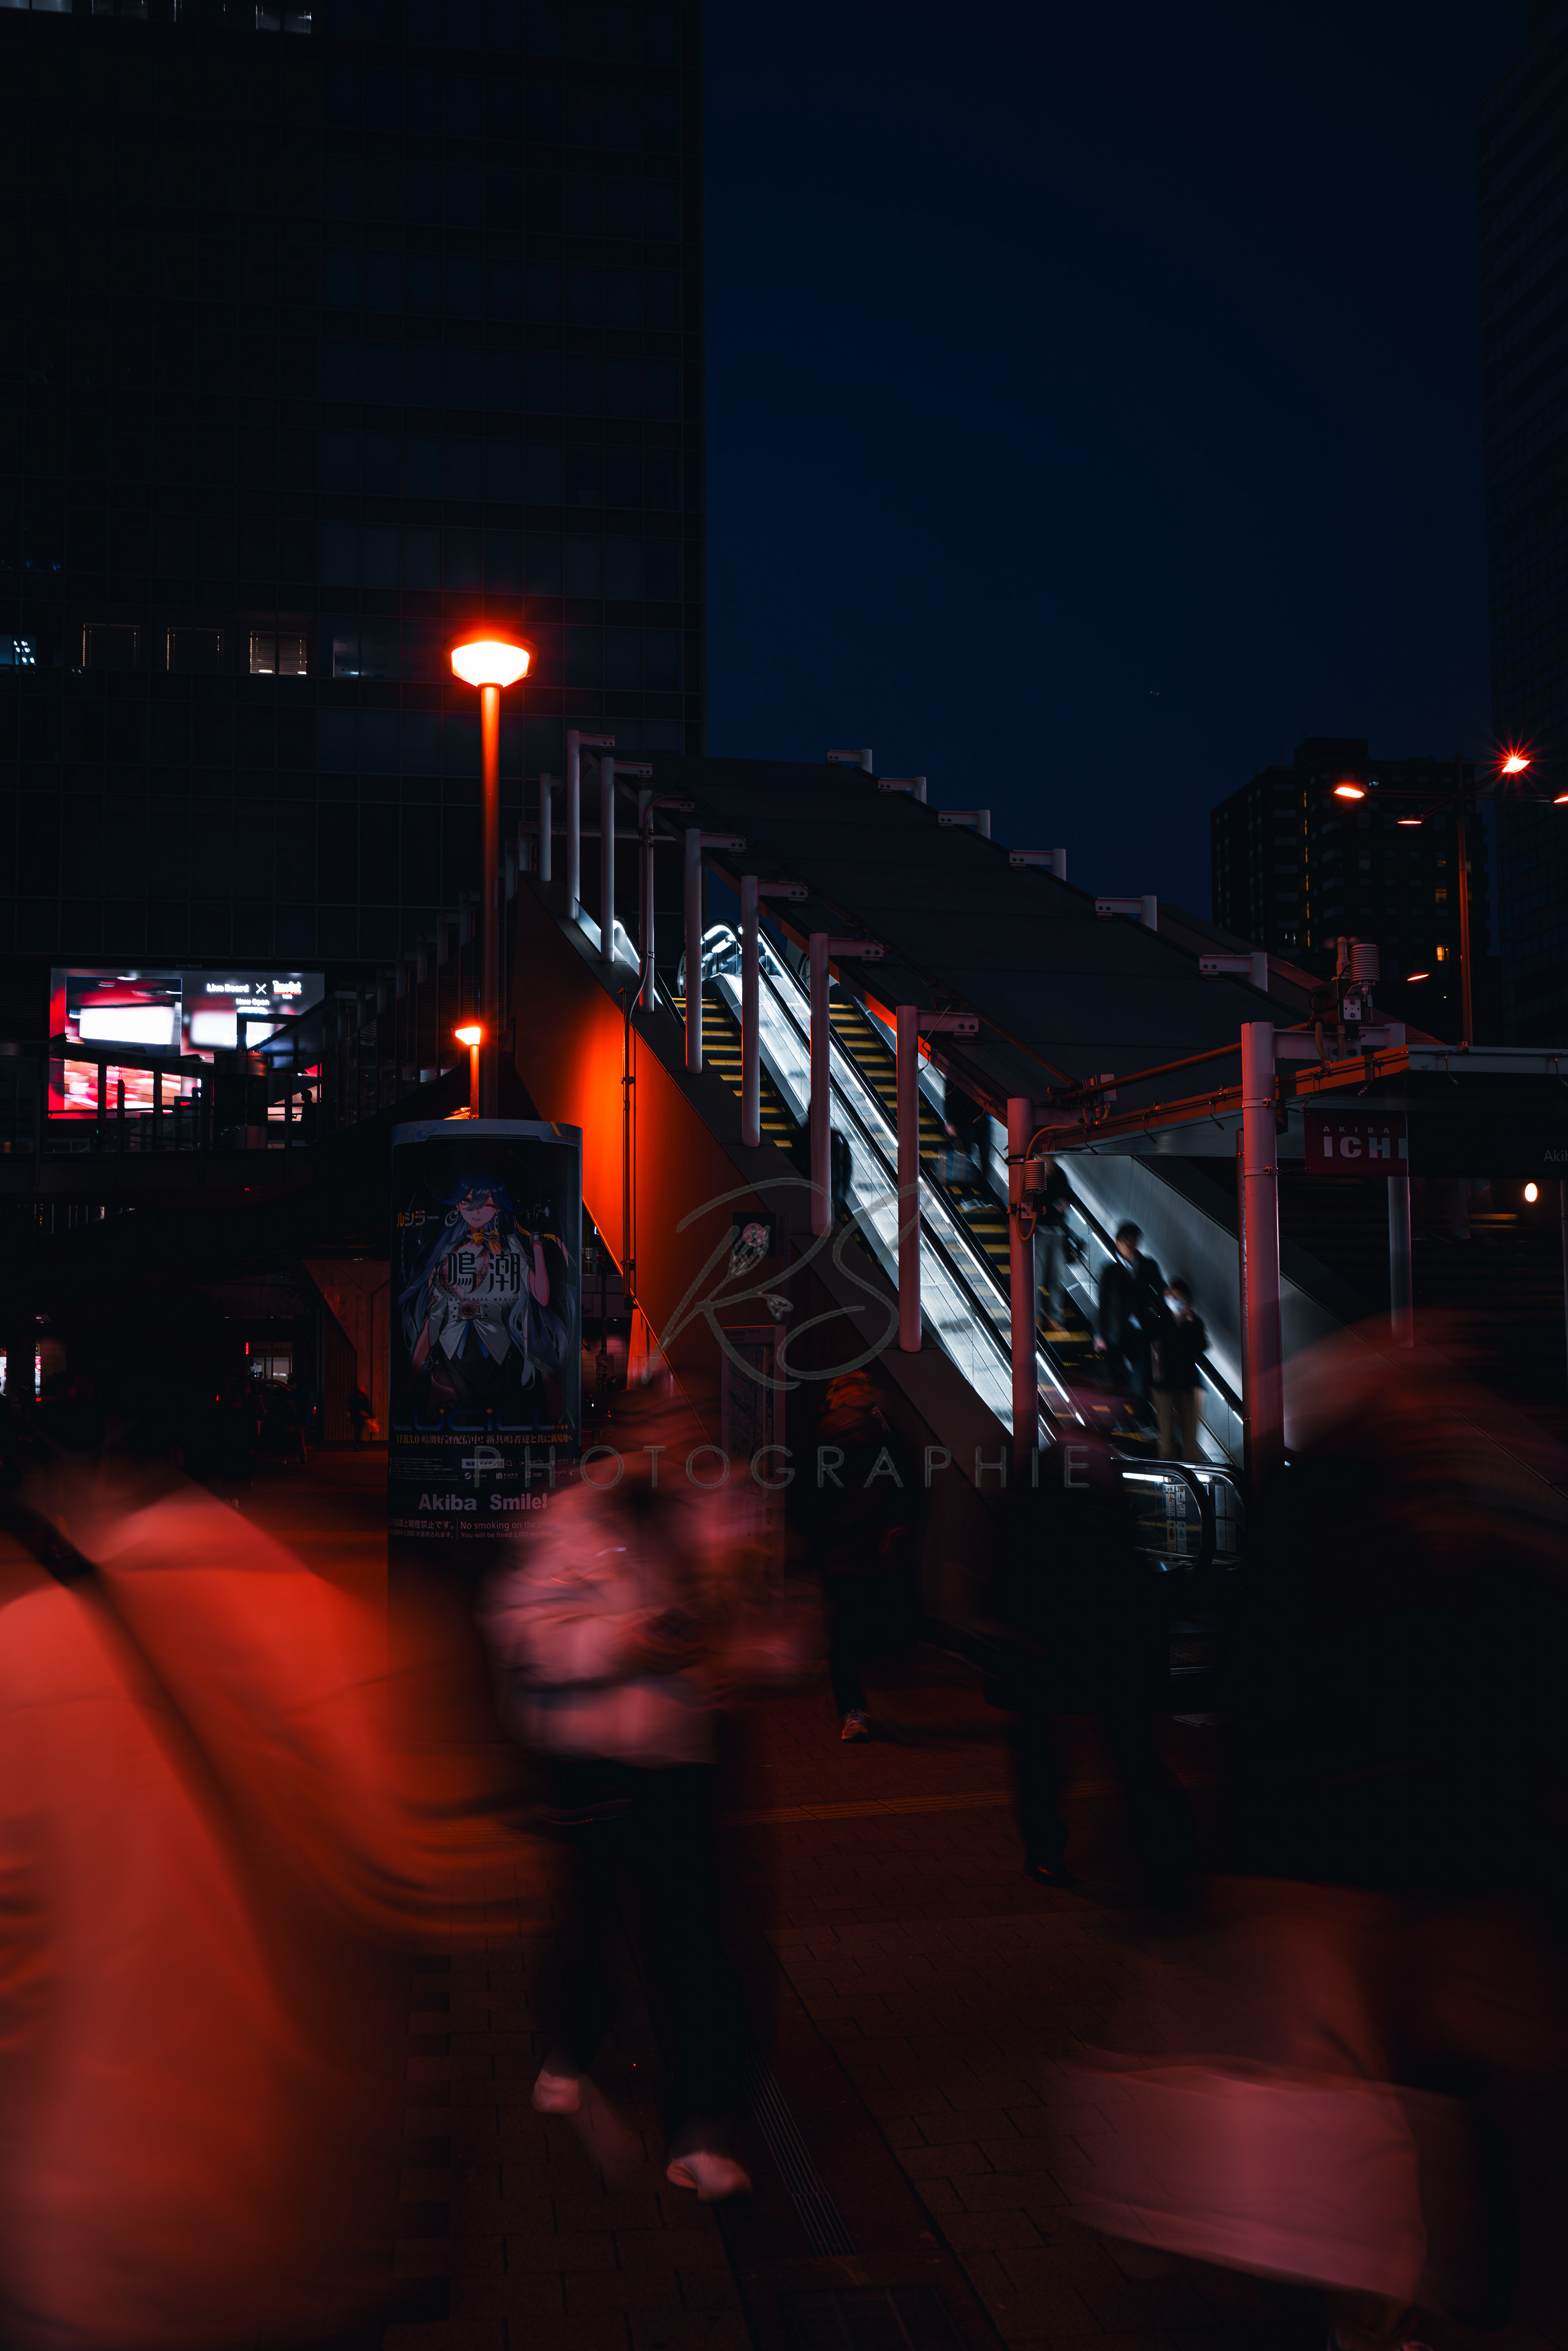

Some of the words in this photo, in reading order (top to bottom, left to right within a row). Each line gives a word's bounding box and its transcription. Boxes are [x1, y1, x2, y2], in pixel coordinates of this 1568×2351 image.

[1323, 1136, 1408, 1159] ICHI
[397, 1210, 439, 1228] ルシラー
[446, 1251, 521, 1295] 鳴潮
[396, 1434, 420, 1444] VER3.0
[419, 1493, 477, 1511] Akiba
[490, 1493, 548, 1511] Smile!
[461, 1521, 472, 1529] No
[474, 1521, 509, 1531] smoking
